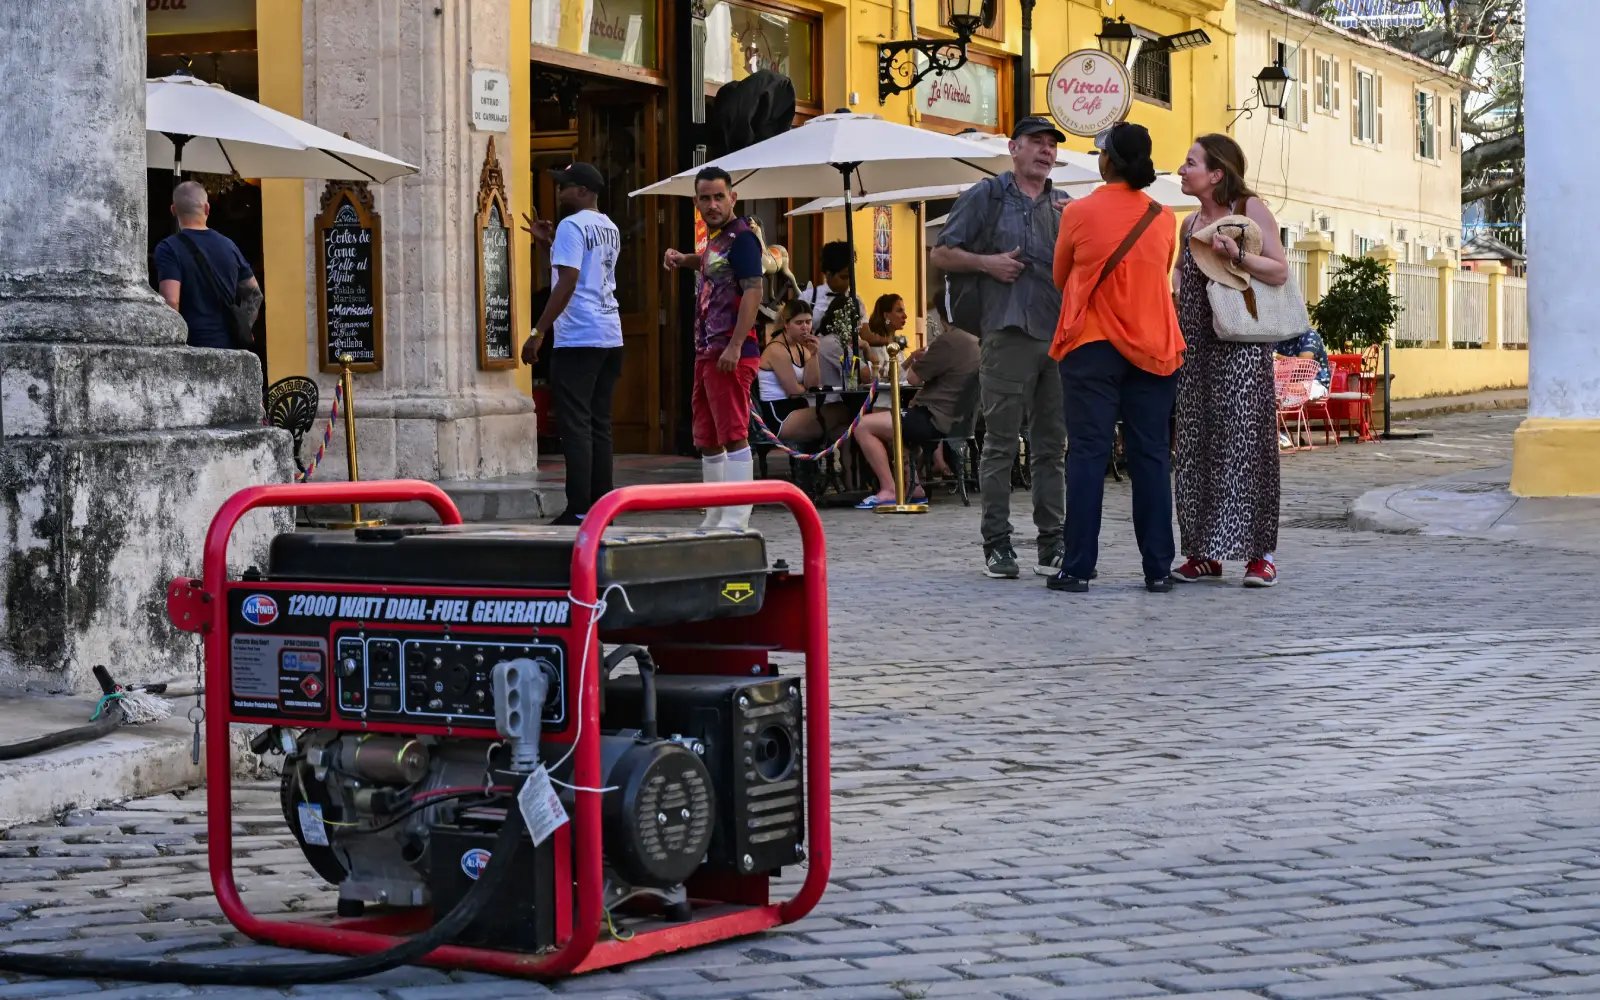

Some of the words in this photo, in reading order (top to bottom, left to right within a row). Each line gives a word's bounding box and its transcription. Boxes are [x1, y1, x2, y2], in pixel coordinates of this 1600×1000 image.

[928, 80, 941, 107] La
[944, 83, 971, 104] Vitrola
[1057, 77, 1119, 94] Vitrola
[1072, 96, 1102, 115] Café
[1096, 106, 1118, 127] COFFEE
[359, 229, 370, 244] de
[245, 602, 274, 615] ALL-POWER
[288, 594, 338, 617] 12000
[338, 597, 385, 619] WATT
[384, 598, 469, 622] DUAL-FUEL
[471, 600, 571, 624] GENERATOR
